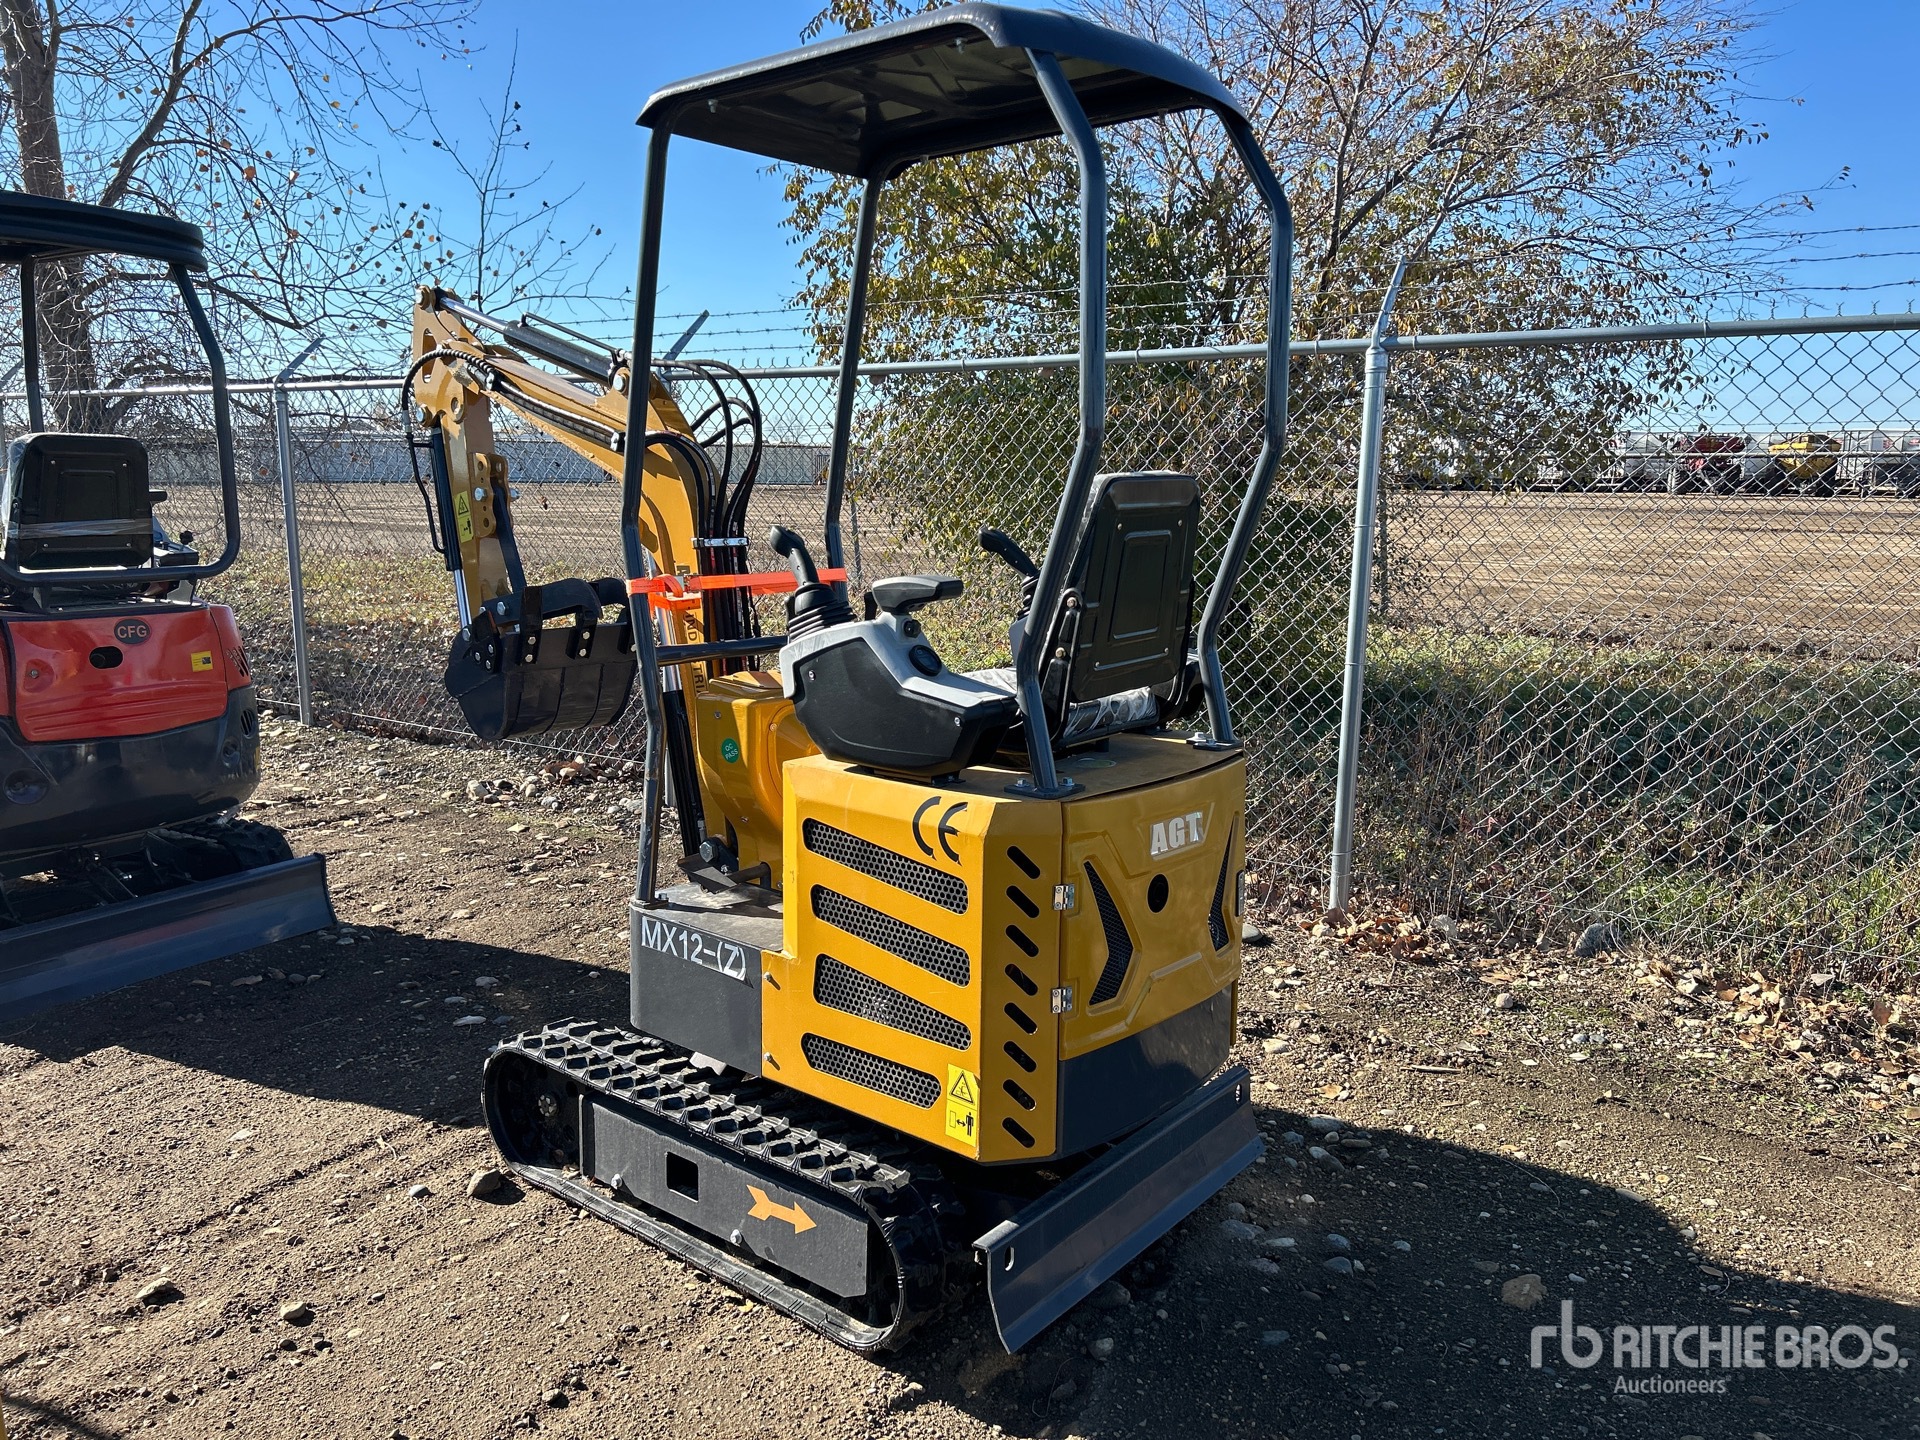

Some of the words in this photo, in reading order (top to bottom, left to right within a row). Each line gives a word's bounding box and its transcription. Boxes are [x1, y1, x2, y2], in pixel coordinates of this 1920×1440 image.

[117, 625, 147, 638] CFG
[683, 613, 706, 694] INDTRI
[724, 743, 734, 752] QC
[725, 748, 738, 760] PASS
[912, 796, 968, 863] CE
[1150, 811, 1204, 856] AGT
[641, 915, 746, 981] MX12-(Z)
